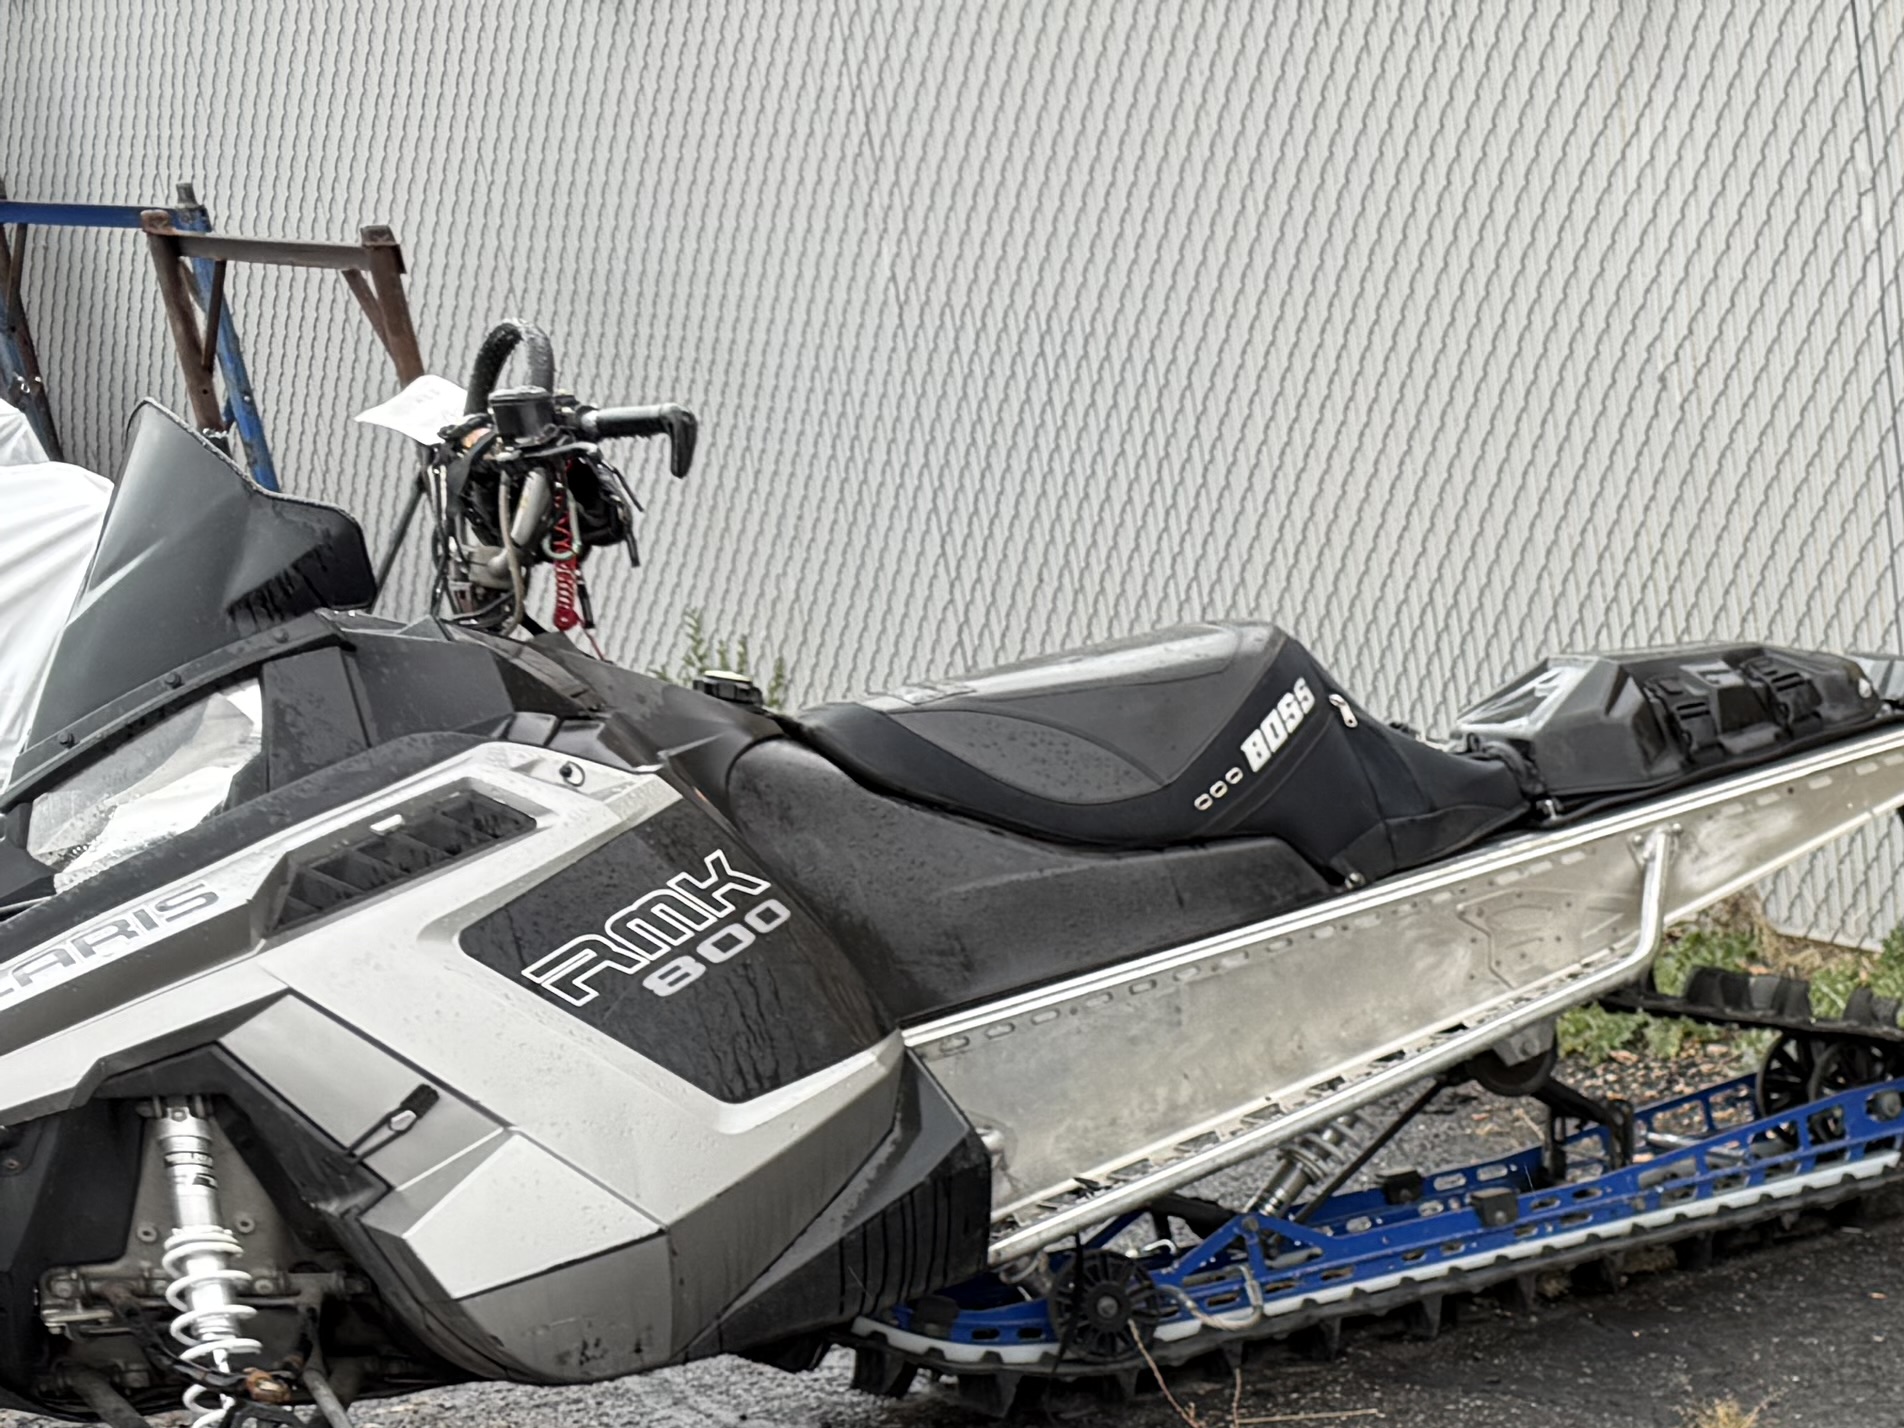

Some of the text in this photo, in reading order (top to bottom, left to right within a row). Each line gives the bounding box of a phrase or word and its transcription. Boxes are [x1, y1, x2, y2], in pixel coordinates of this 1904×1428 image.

[1240, 677, 1315, 773] BOSS
[0, 882, 220, 998] ARIS
[520, 848, 771, 1007] RMK
[642, 898, 791, 997] 800
